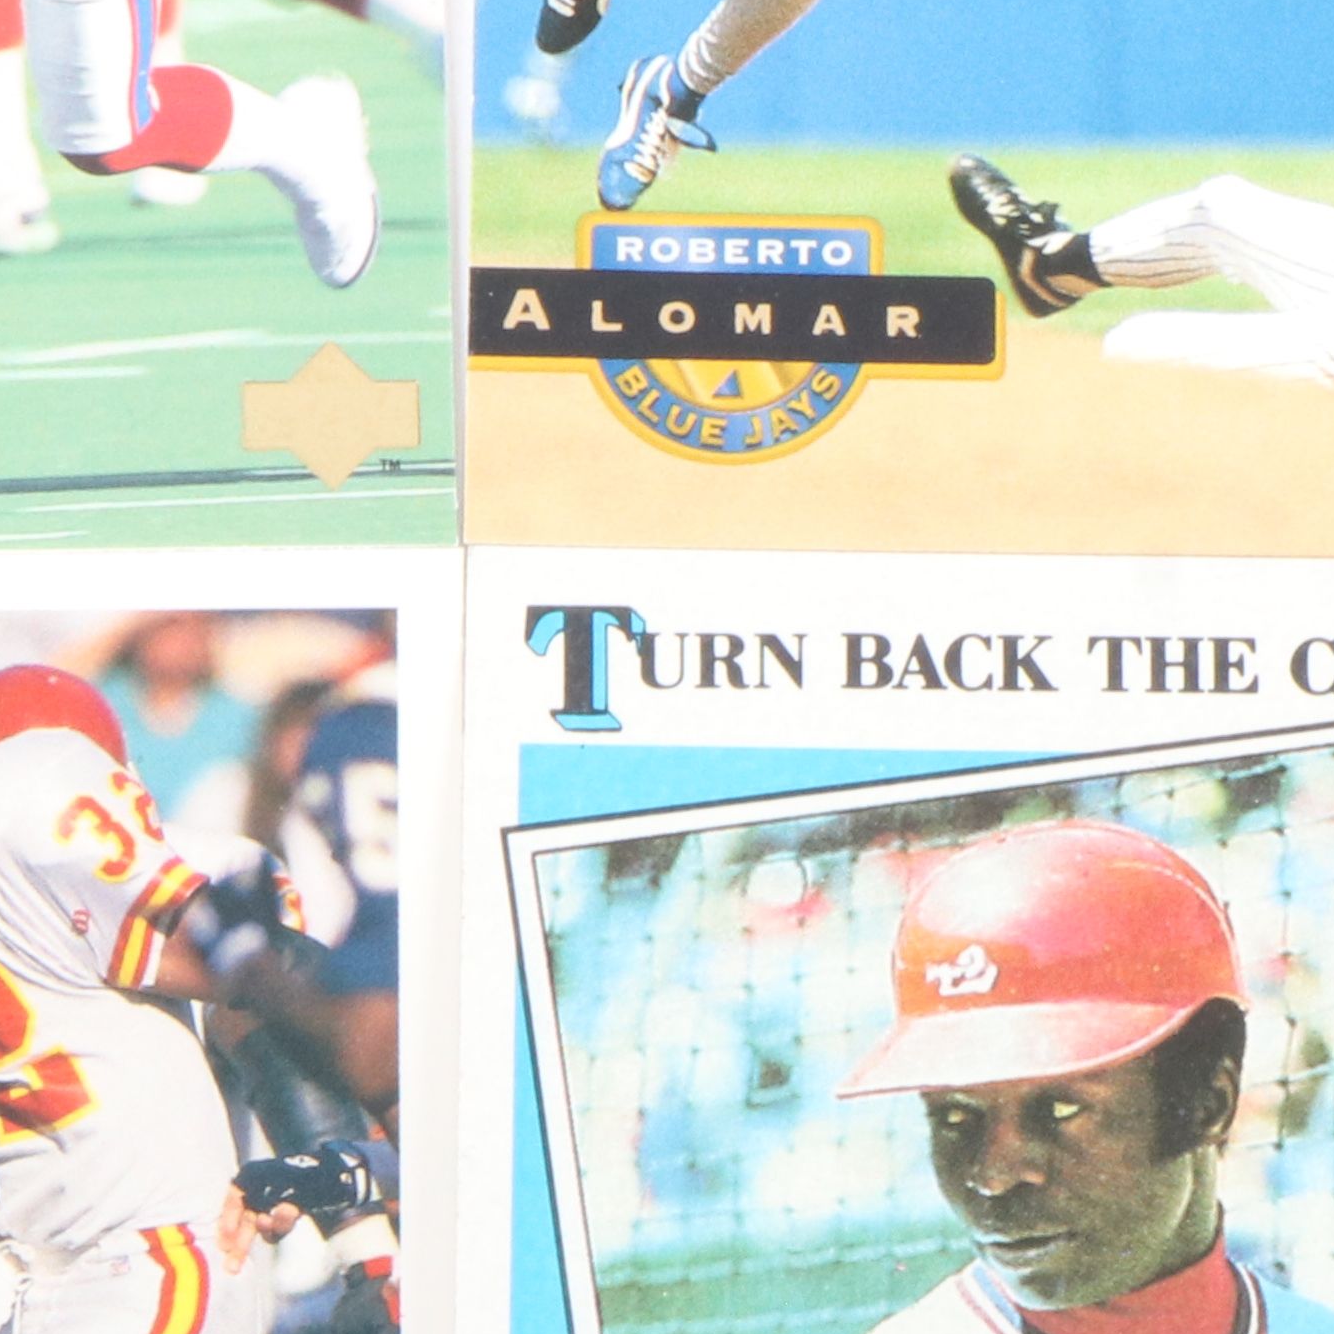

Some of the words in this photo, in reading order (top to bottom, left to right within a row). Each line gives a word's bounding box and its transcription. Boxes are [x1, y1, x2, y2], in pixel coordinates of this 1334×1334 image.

[615, 234, 855, 267] ROBERTO
[502, 287, 923, 339] ALOMAR
[613, 364, 727, 448] BLUE
[743, 369, 843, 448] JAYS
[525, 604, 809, 732] TURN
[840, 632, 1060, 692] BACK
[1086, 636, 1261, 694] THE
